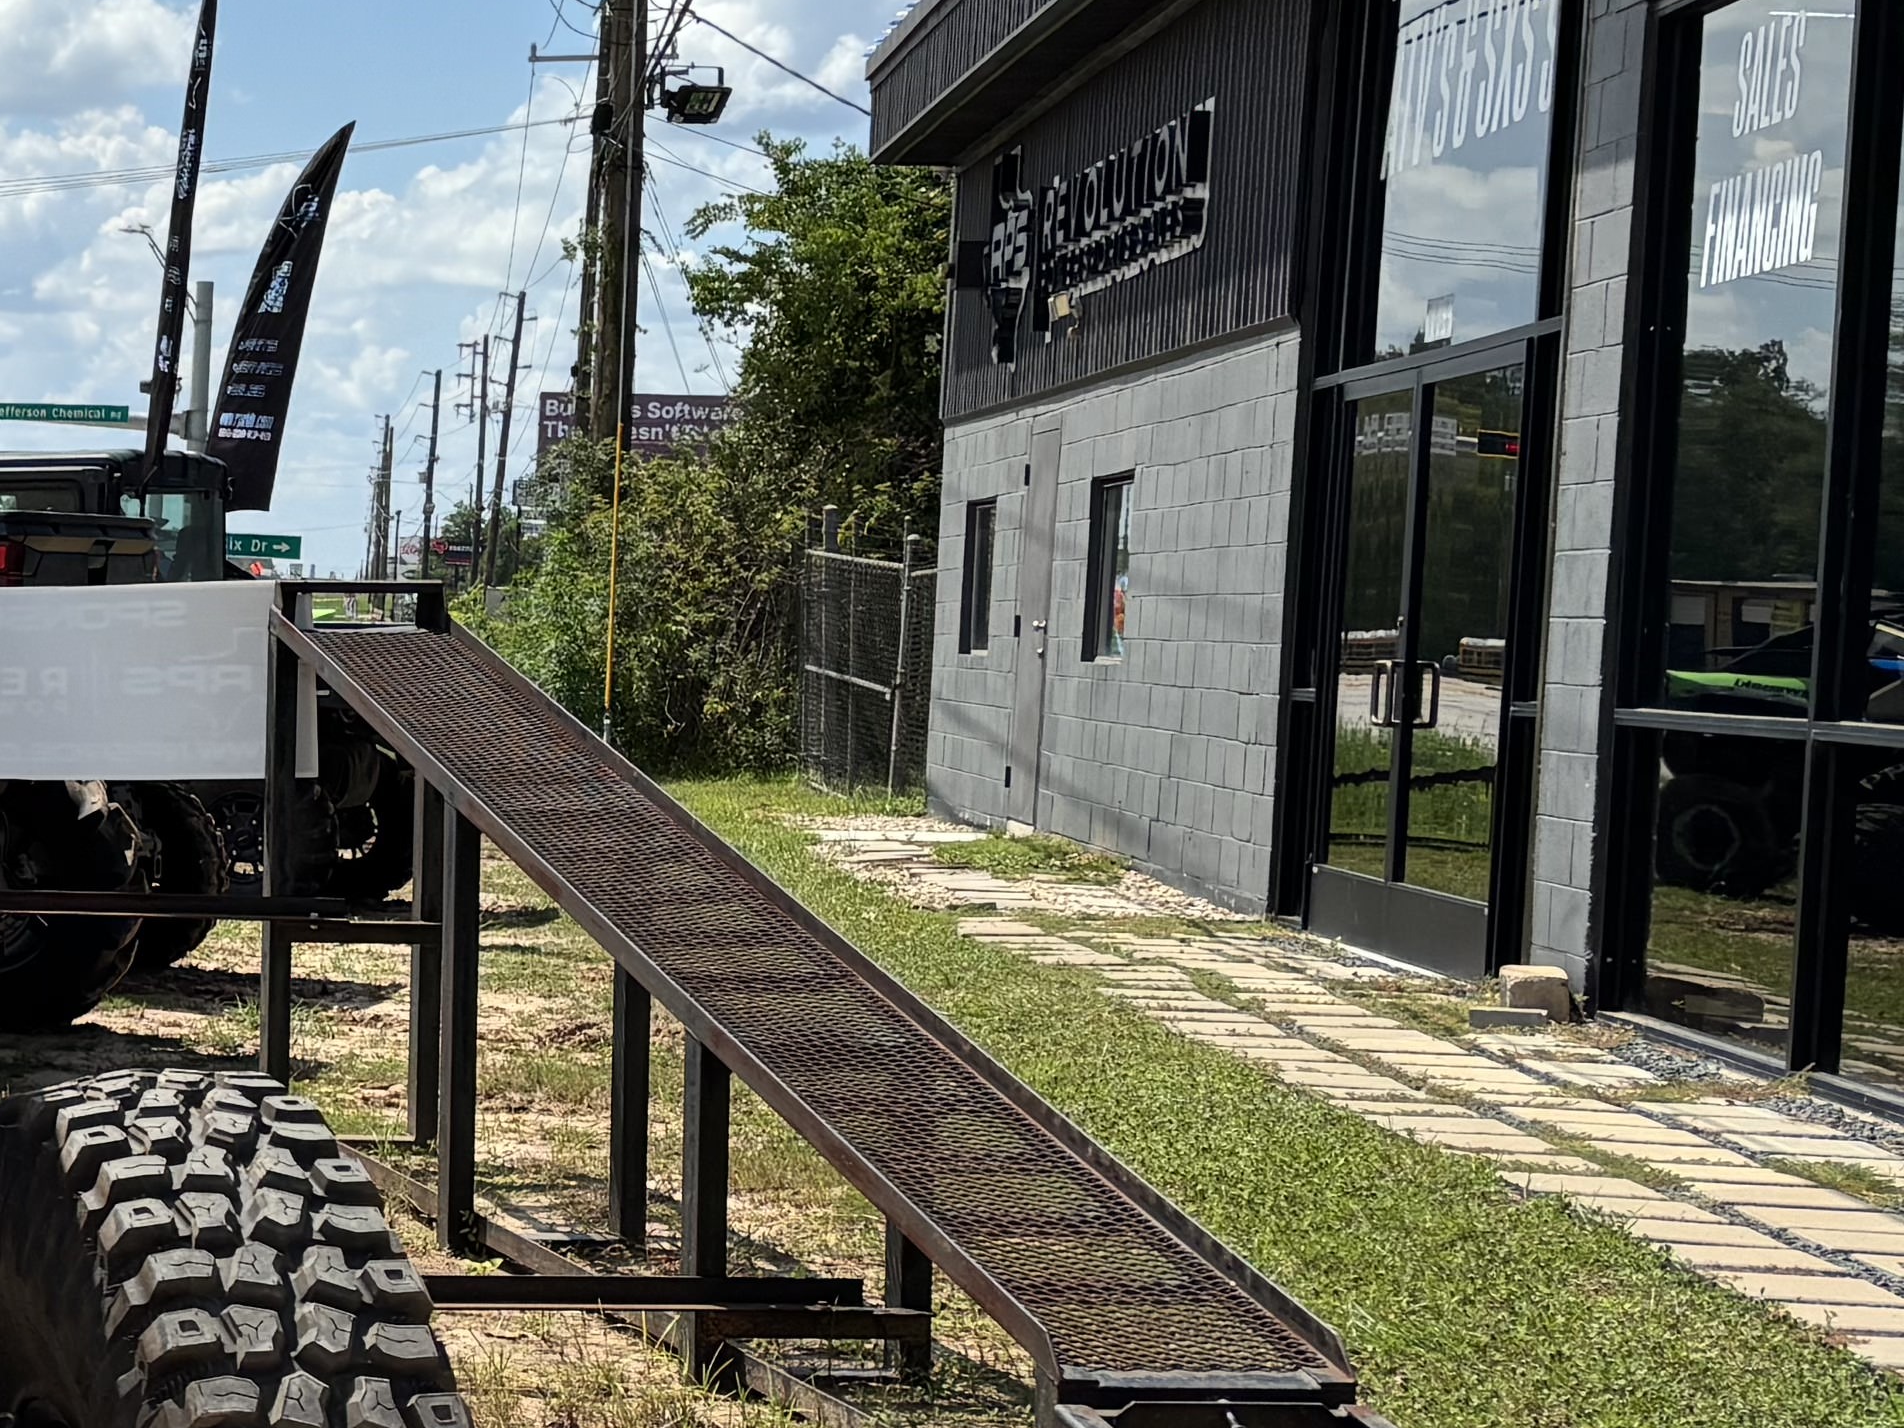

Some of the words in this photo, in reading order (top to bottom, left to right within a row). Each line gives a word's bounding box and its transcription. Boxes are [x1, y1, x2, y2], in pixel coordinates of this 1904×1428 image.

[1732, 10, 1806, 138] SALES
[1042, 114, 1196, 256] REVOLUTION
[1700, 149, 1823, 288] FINANCING
[51, 407, 105, 419] Chemical
[647, 401, 744, 421] Software
[250, 539, 269, 553] Dr
